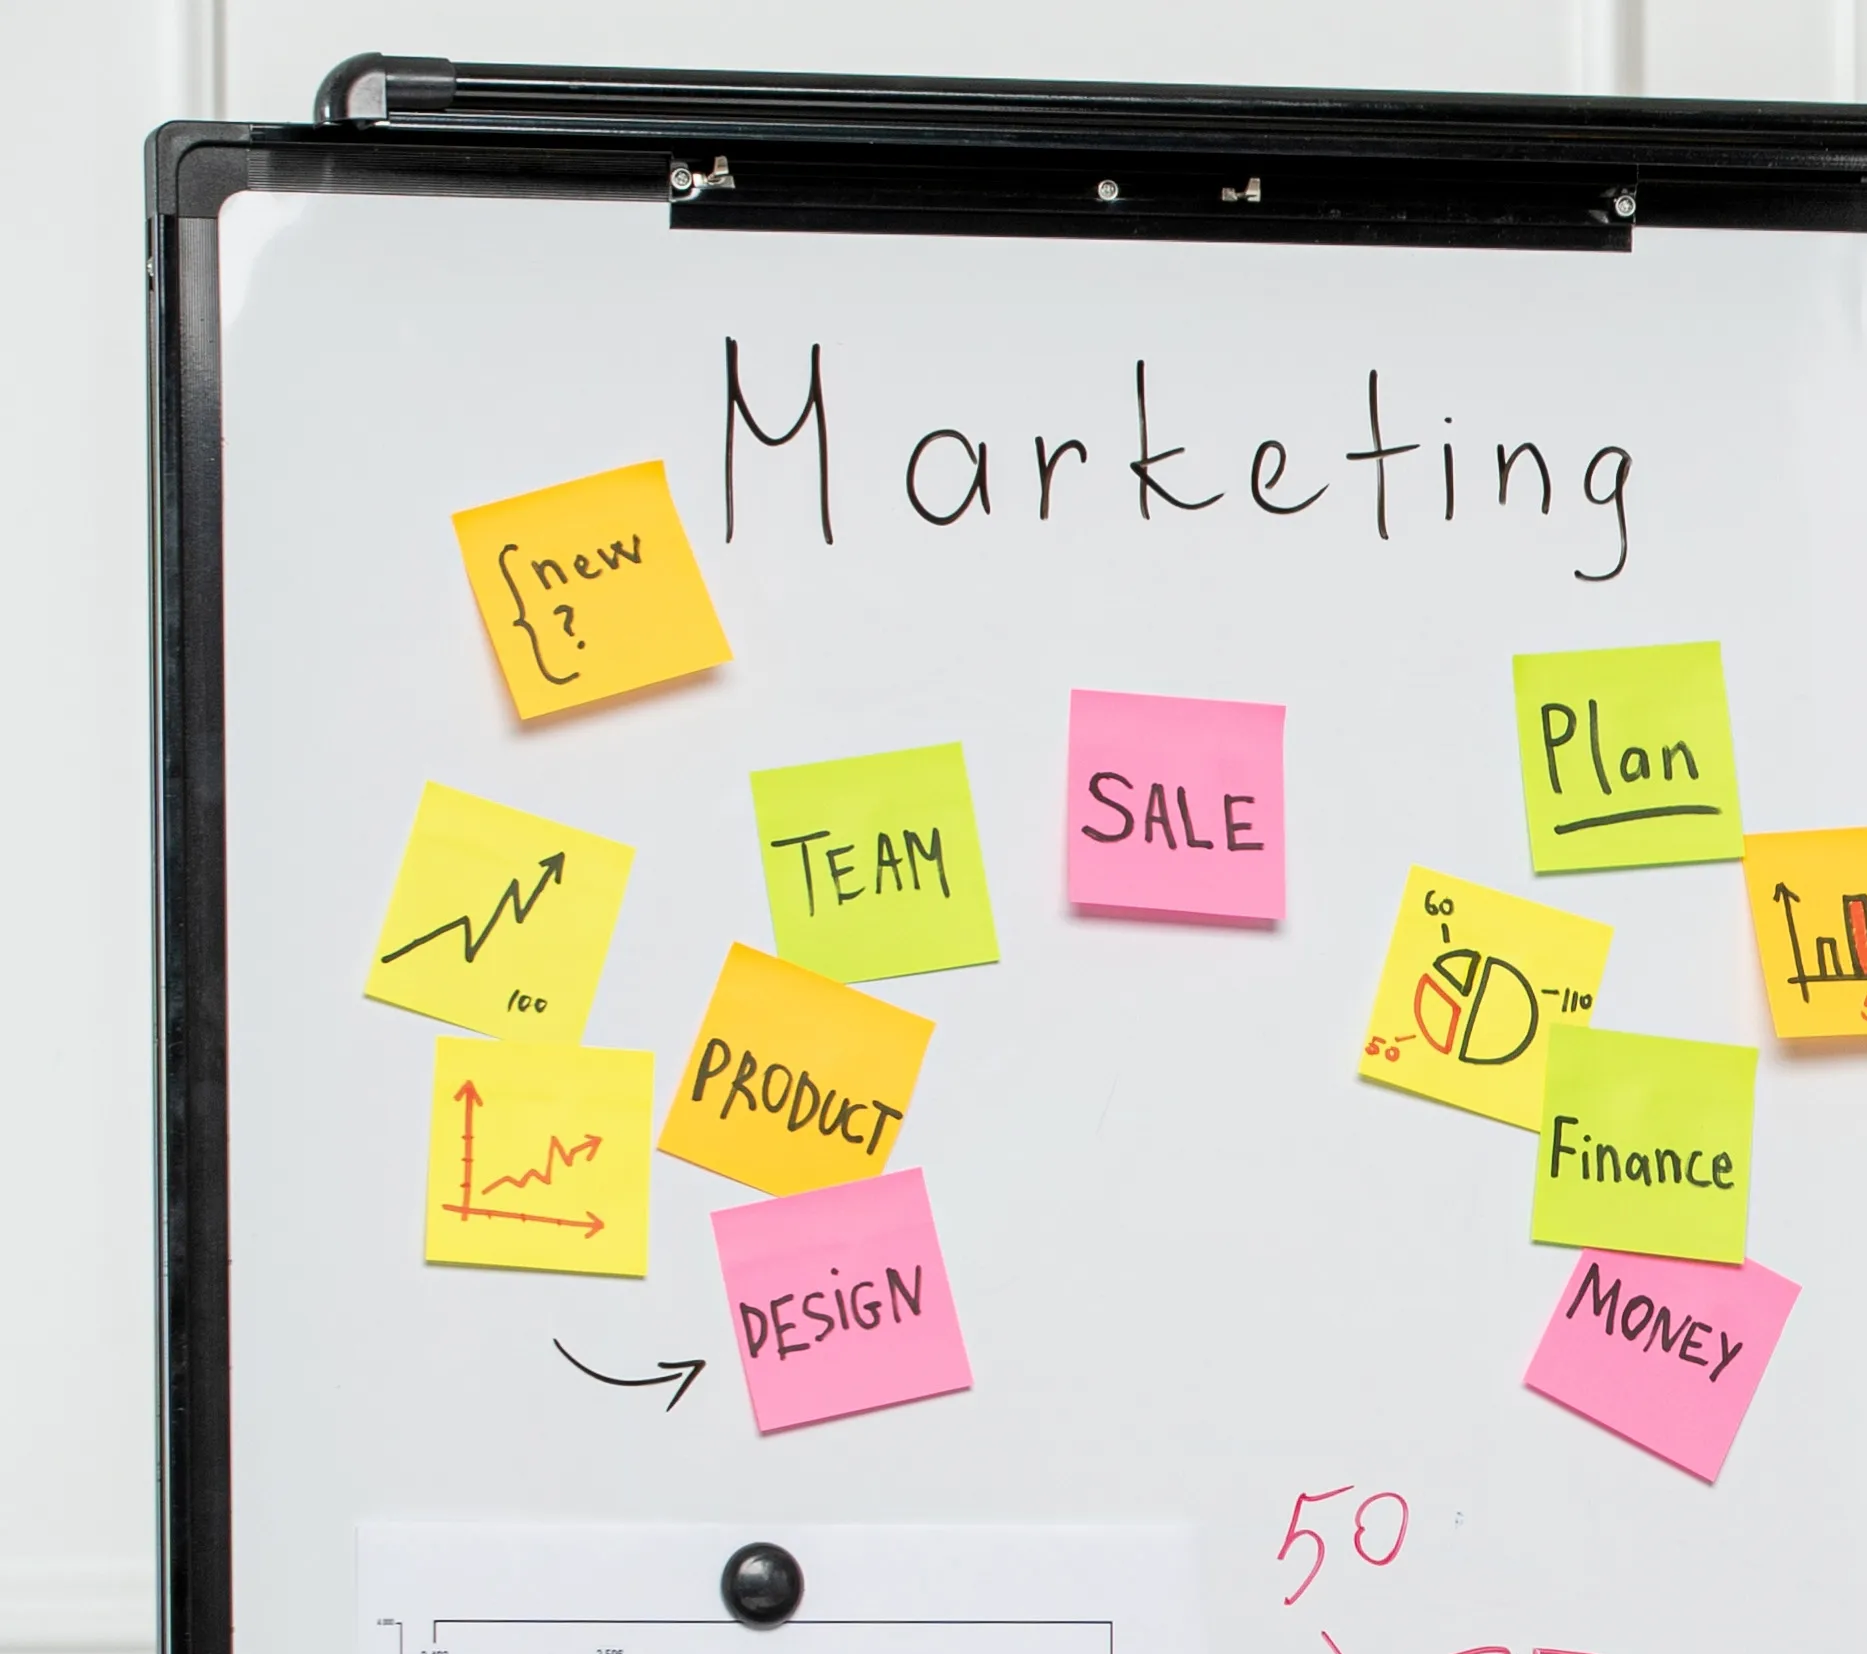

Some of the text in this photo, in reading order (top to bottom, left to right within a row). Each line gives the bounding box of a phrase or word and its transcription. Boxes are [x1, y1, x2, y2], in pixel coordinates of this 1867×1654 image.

[724, 335, 1637, 582] Marketing
[1540, 698, 1700, 794] Plan
[1082, 772, 1266, 852] SALE
[770, 826, 951, 918] TEAM
[1424, 890, 1454, 918] 60
[507, 990, 548, 1014] 100
[691, 1036, 904, 1154] PRODUCT
[1550, 1115, 1734, 1190] Finance
[1566, 1262, 1743, 1382] MONEY
[1277, 1483, 1409, 1606] 50
